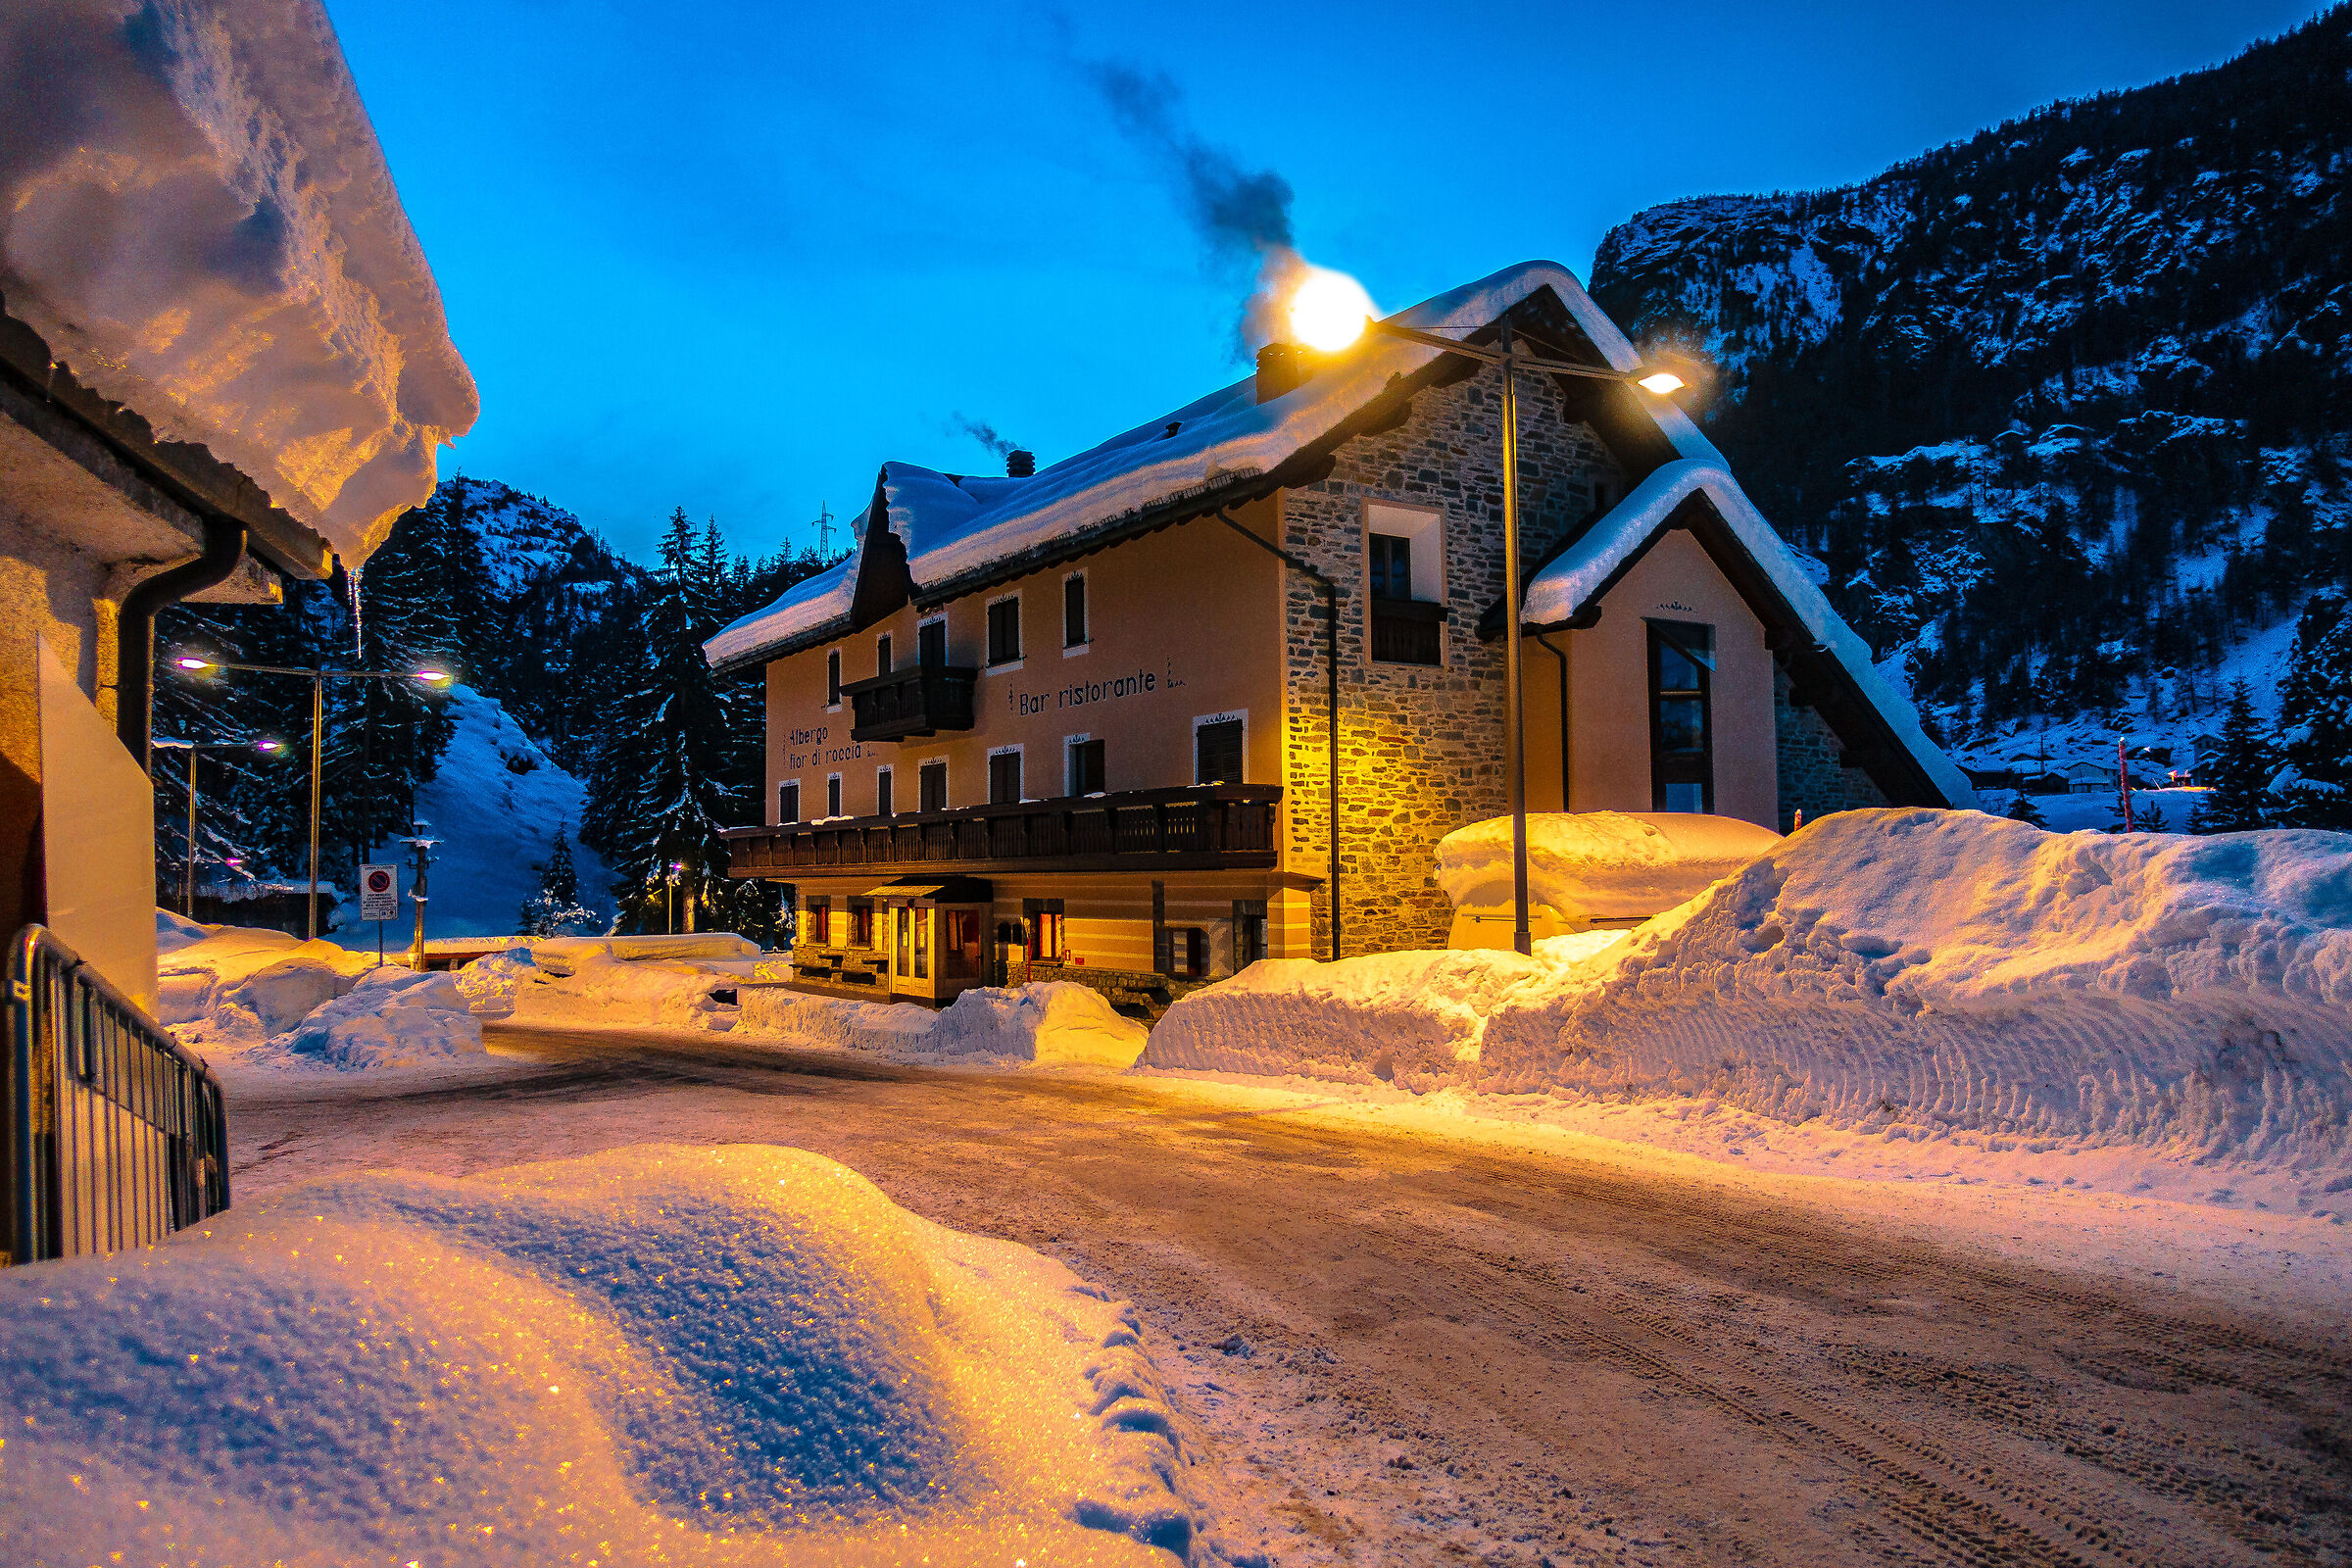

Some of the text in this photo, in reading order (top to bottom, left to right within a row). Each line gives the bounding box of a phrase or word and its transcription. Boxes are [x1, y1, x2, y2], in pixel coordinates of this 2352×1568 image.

[1019, 668, 1155, 715] Bar ristorante
[789, 727, 828, 746] Albergo
[811, 750, 821, 766] di
[826, 742, 861, 764] roccia
